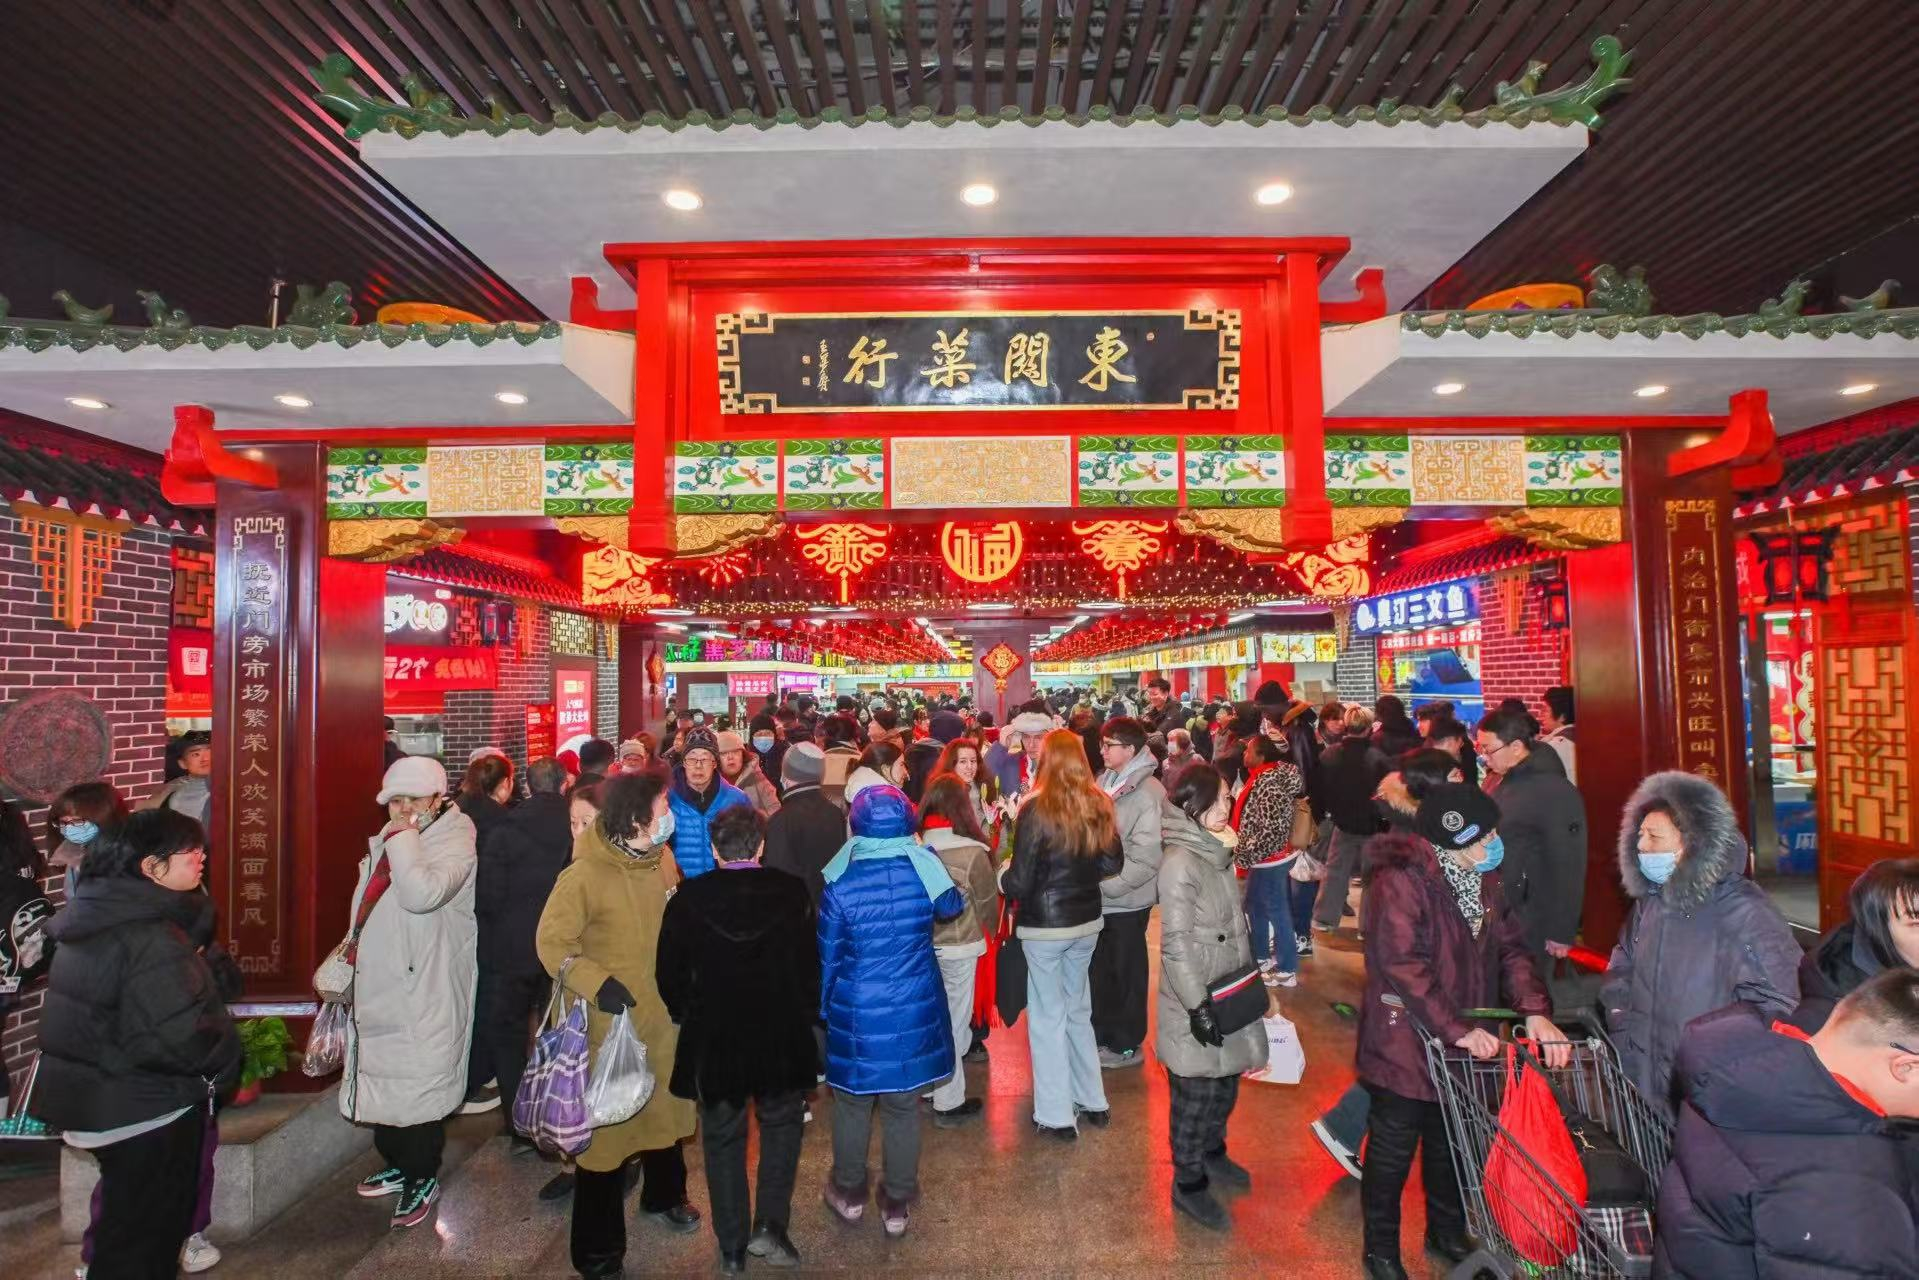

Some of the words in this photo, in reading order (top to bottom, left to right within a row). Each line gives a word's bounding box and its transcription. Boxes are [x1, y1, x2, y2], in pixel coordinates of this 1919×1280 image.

[240, 561, 272, 926] 抚近门旁市场繁荣人欢笑满面春风
